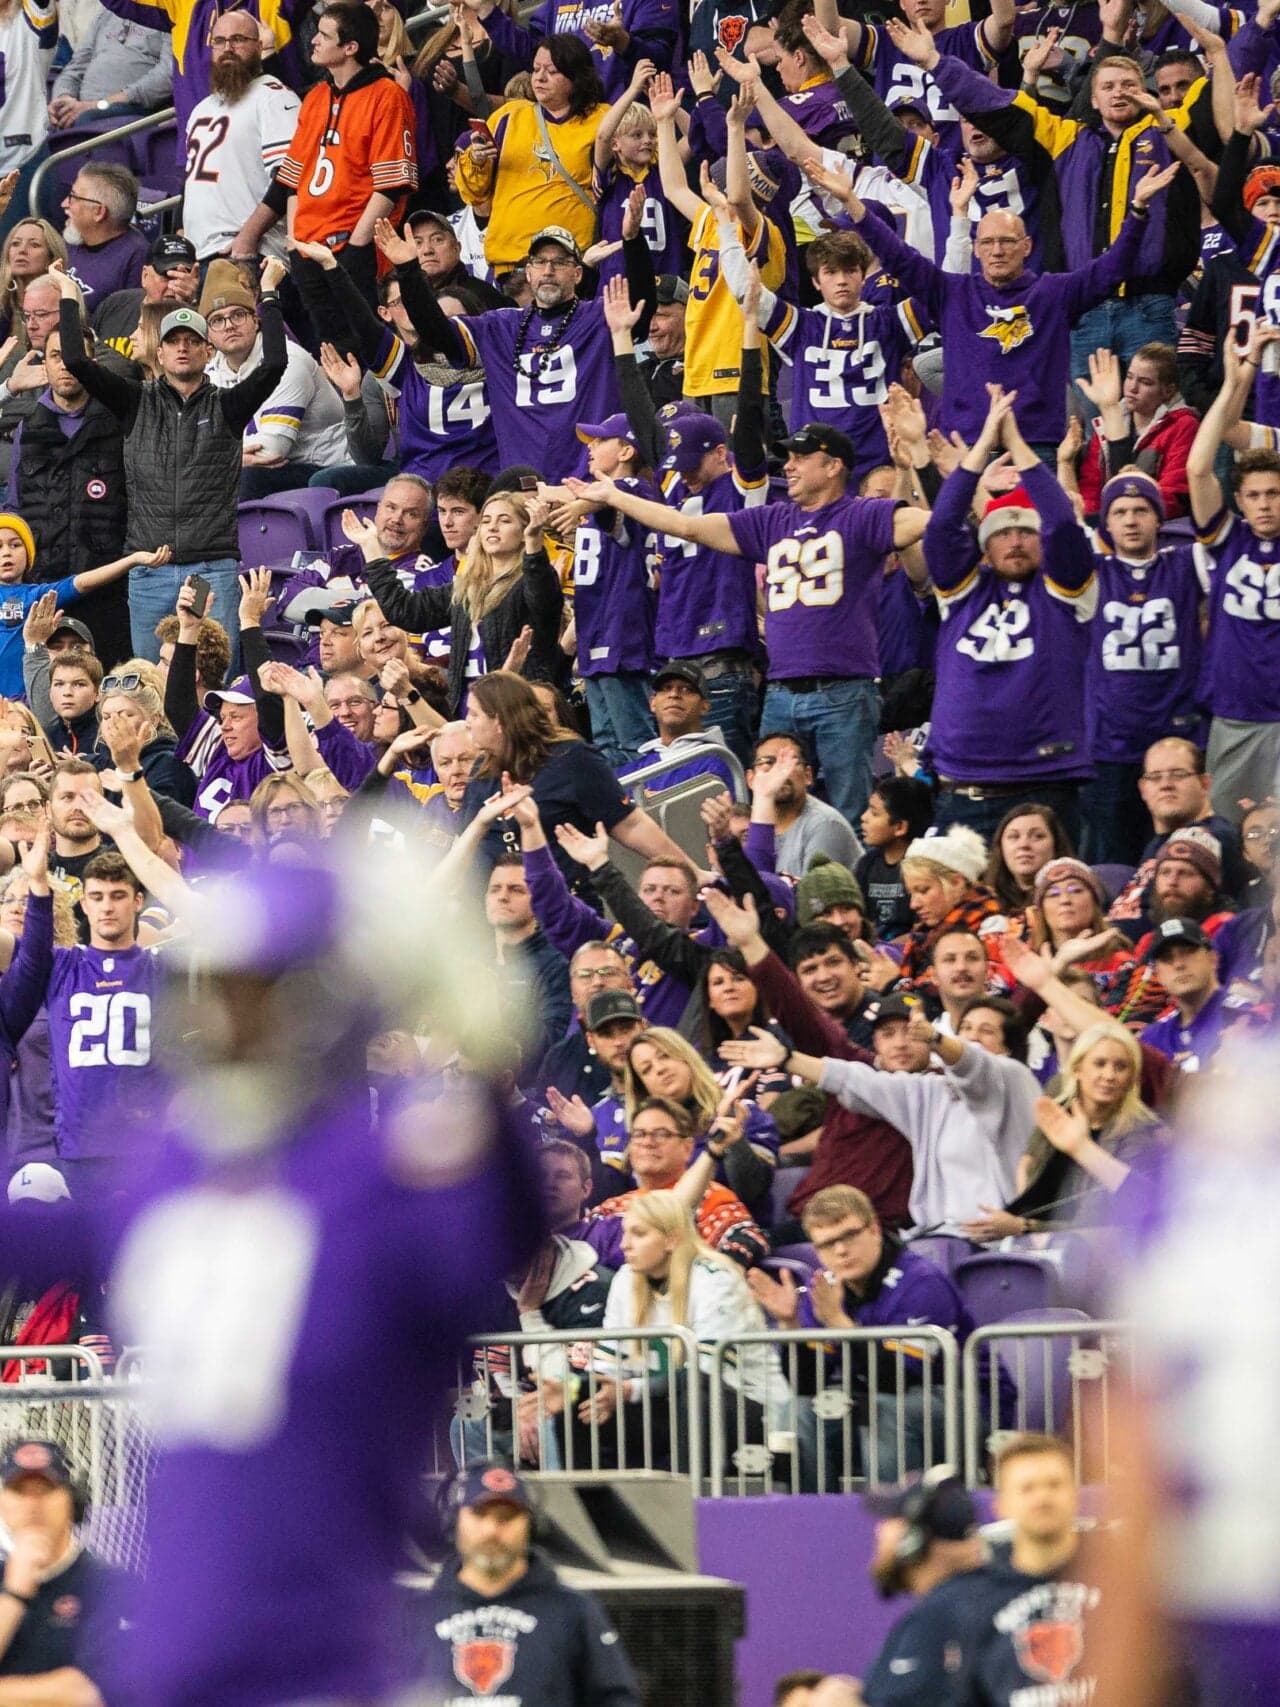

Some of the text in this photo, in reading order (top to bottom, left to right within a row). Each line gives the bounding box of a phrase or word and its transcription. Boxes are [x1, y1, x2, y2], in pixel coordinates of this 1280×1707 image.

[185, 117, 231, 184] 52
[622, 197, 666, 251] 9
[1202, 232, 1223, 250] 22
[516, 344, 577, 407] 19
[804, 341, 889, 408] 33
[428, 382, 490, 436] 14
[1102, 598, 1179, 671] 22
[69, 991, 152, 1068] 20
